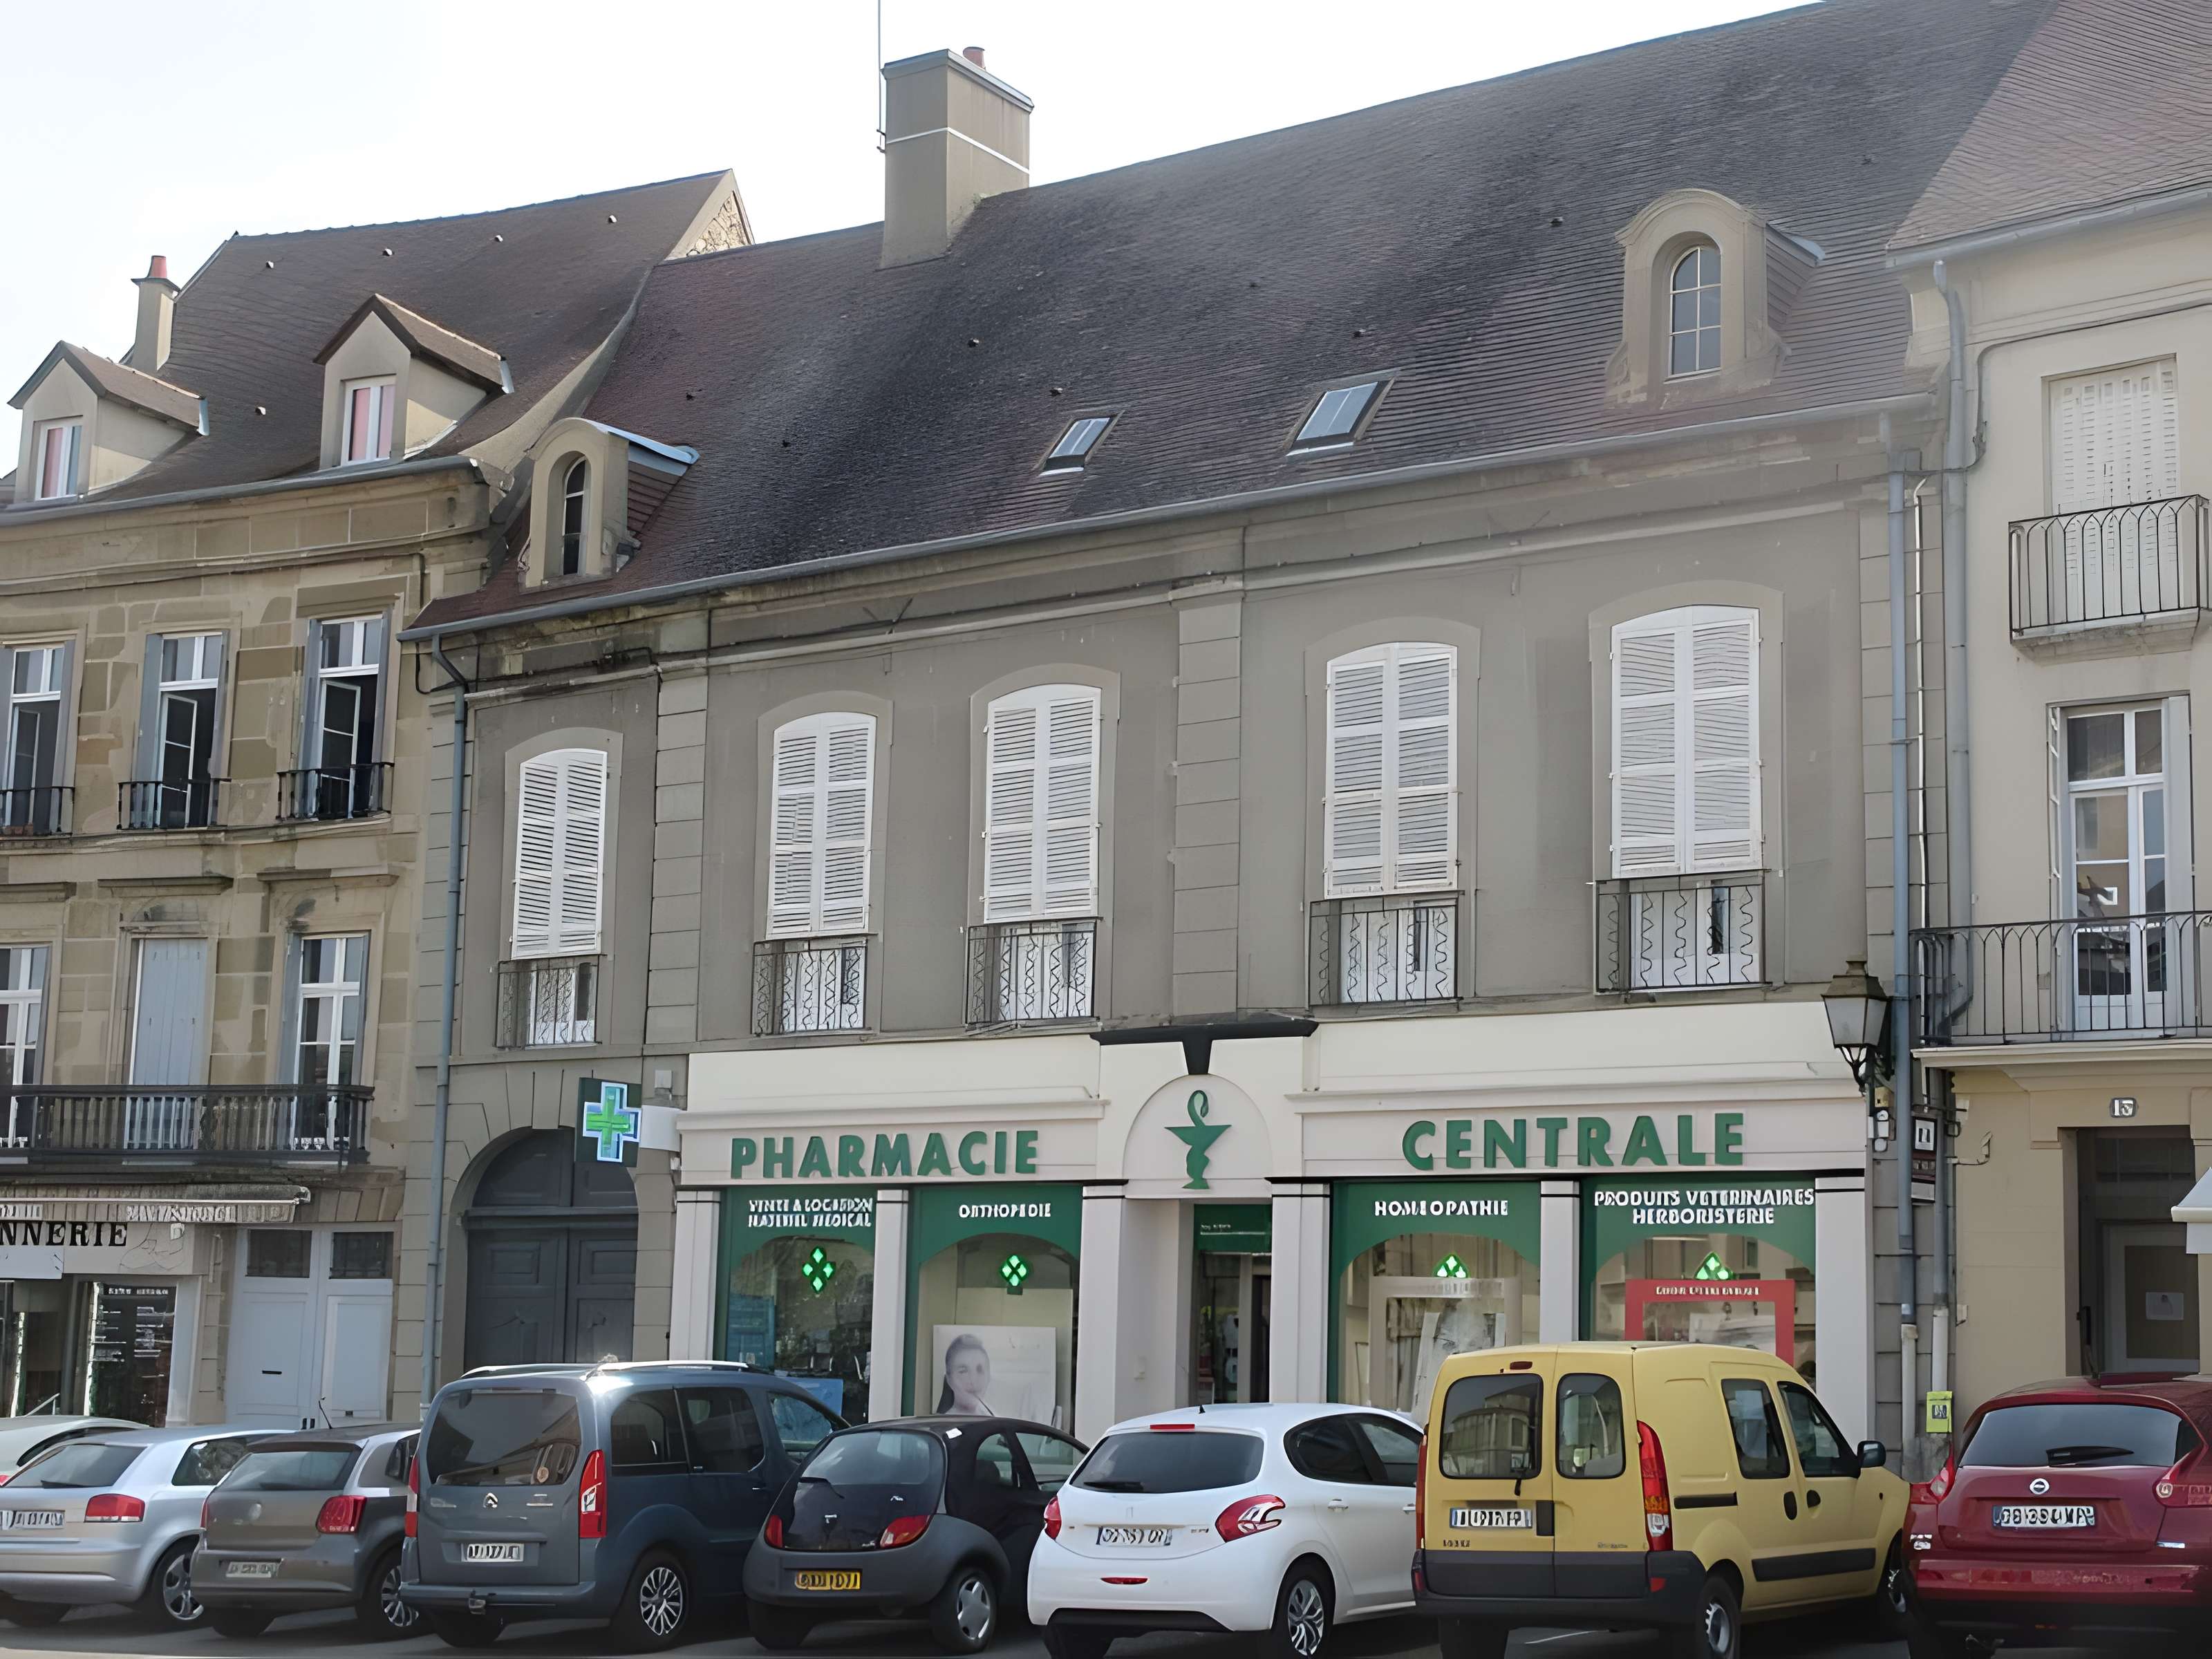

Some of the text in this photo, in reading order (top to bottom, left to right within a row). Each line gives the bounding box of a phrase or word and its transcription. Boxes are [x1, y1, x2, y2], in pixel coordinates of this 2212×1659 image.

[731, 1130, 1038, 1179] PHARMACIE
[1402, 1112, 1744, 1171] CENTRALE
[1593, 1190, 1681, 1206] PRODUITS
